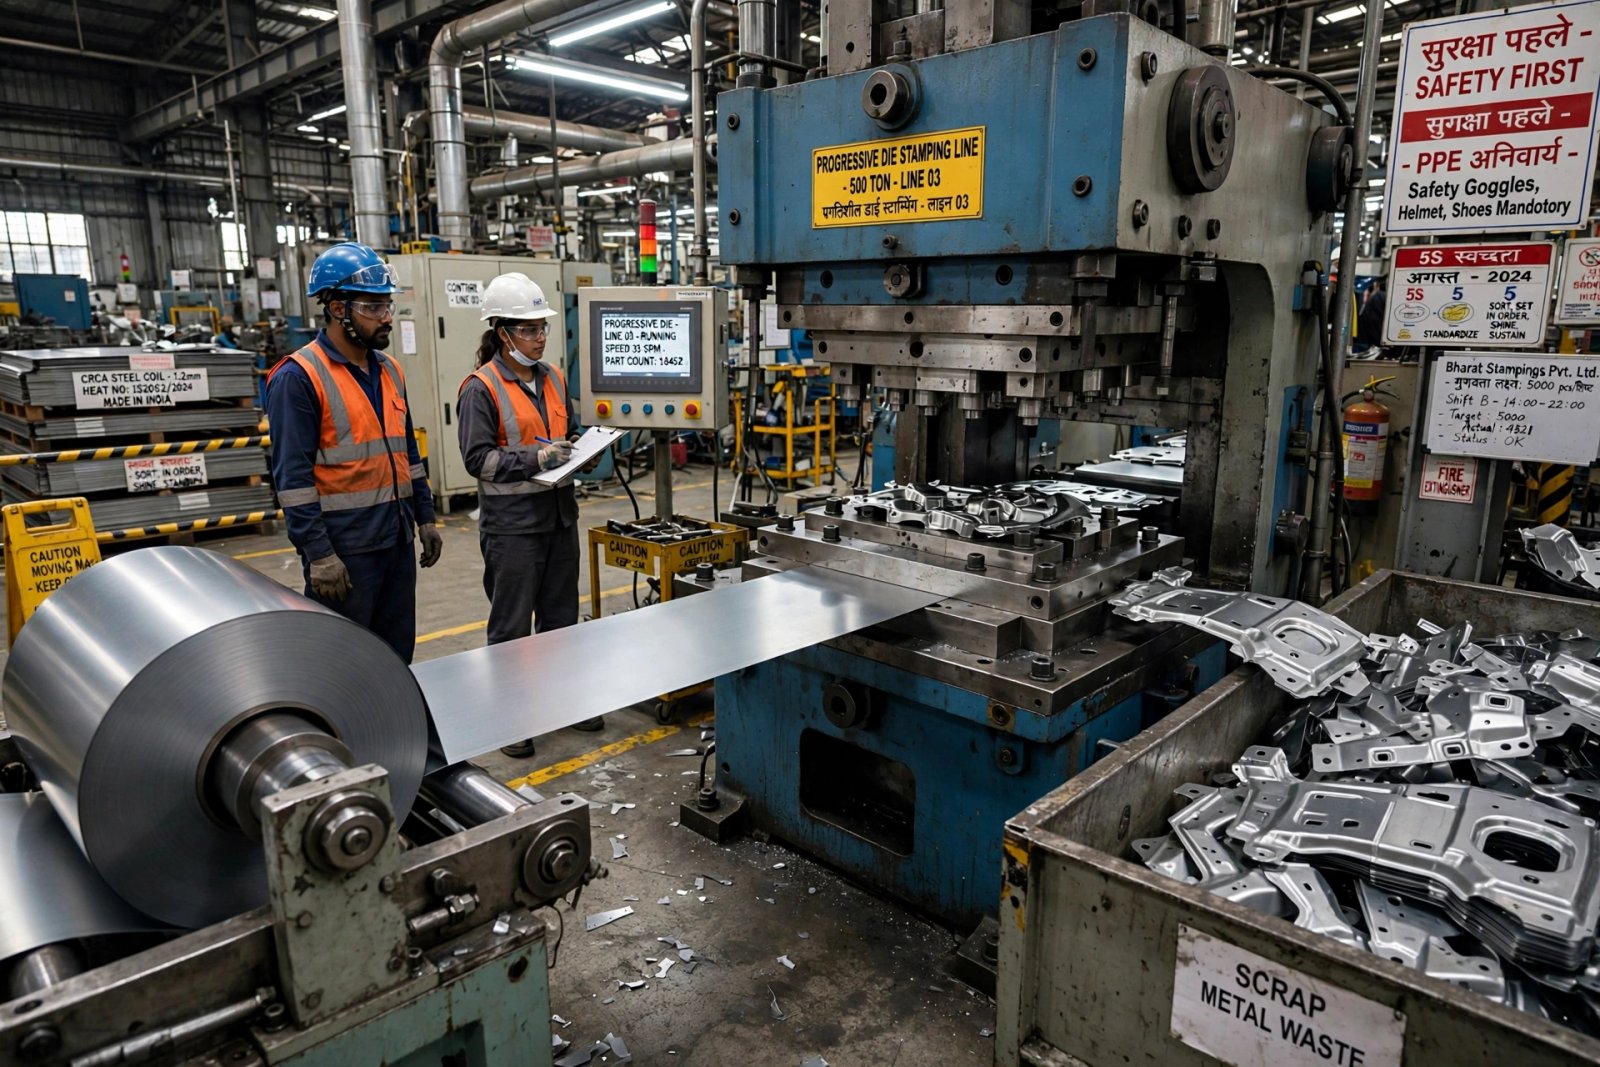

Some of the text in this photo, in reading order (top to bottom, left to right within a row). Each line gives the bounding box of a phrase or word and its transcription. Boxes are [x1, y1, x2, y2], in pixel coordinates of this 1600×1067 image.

[1421, 13, 1573, 72] सुरक्षा पहले
[1415, 57, 1584, 99] SAFETY FIRST
[1498, 100, 1553, 128] पहले
[817, 137, 979, 174] PROGRESSIVE DIE STAMPING LINE
[1417, 136, 1562, 174] PPE अनिवार्य
[850, 168, 941, 195] 500 TON LINE 03
[1408, 176, 1540, 200] Safety Goggles,
[927, 196, 953, 212] लाइन
[956, 194, 969, 210] 03
[1398, 198, 1571, 220] Helmet, Shoes Mandotory
[1419, 250, 1443, 265] 5S
[1407, 270, 1532, 284] अगस्त 2024
[1406, 286, 1516, 301] 5S 5 5
[1515, 302, 1533, 310] SET
[605, 319, 673, 328] PROGRESSIVE DIE
[1486, 312, 1495, 320] IN
[605, 331, 622, 341] LINE
[641, 331, 677, 341] RUNNING
[1424, 330, 1526, 339] STANDARDIZE SUSTAIN
[605, 344, 630, 353] SPEED
[643, 344, 661, 353] SPM
[605, 356, 625, 366] PART
[627, 356, 657, 366] COUNT:
[1446, 361, 1600, 378] Bharat Stampings Pvt. Ltd.
[81, 374, 108, 384] CRCA
[111, 373, 141, 383] STEEL
[143, 372, 165, 381] COIL
[1527, 380, 1555, 390] 5000
[83, 385, 108, 395] HEAT
[112, 384, 129, 394] NO:
[103, 397, 131, 407] MADE
[133, 396, 142, 405] IN
[1445, 393, 1474, 407] Shift
[1480, 395, 1489, 406] B
[1496, 411, 1526, 422] 5000
[1504, 436, 1526, 448] OK
[1438, 466, 1465, 482] FIRE
[30, 546, 81, 563] CAUTION
[610, 540, 648, 559] CAUTION
[679, 538, 724, 558] CAUTION
[31, 560, 73, 578] MOVING
[35, 578, 61, 593] KEEP
[1236, 963, 1326, 1018] SCRAP
[1201, 980, 1365, 1067] METAL WASTE
